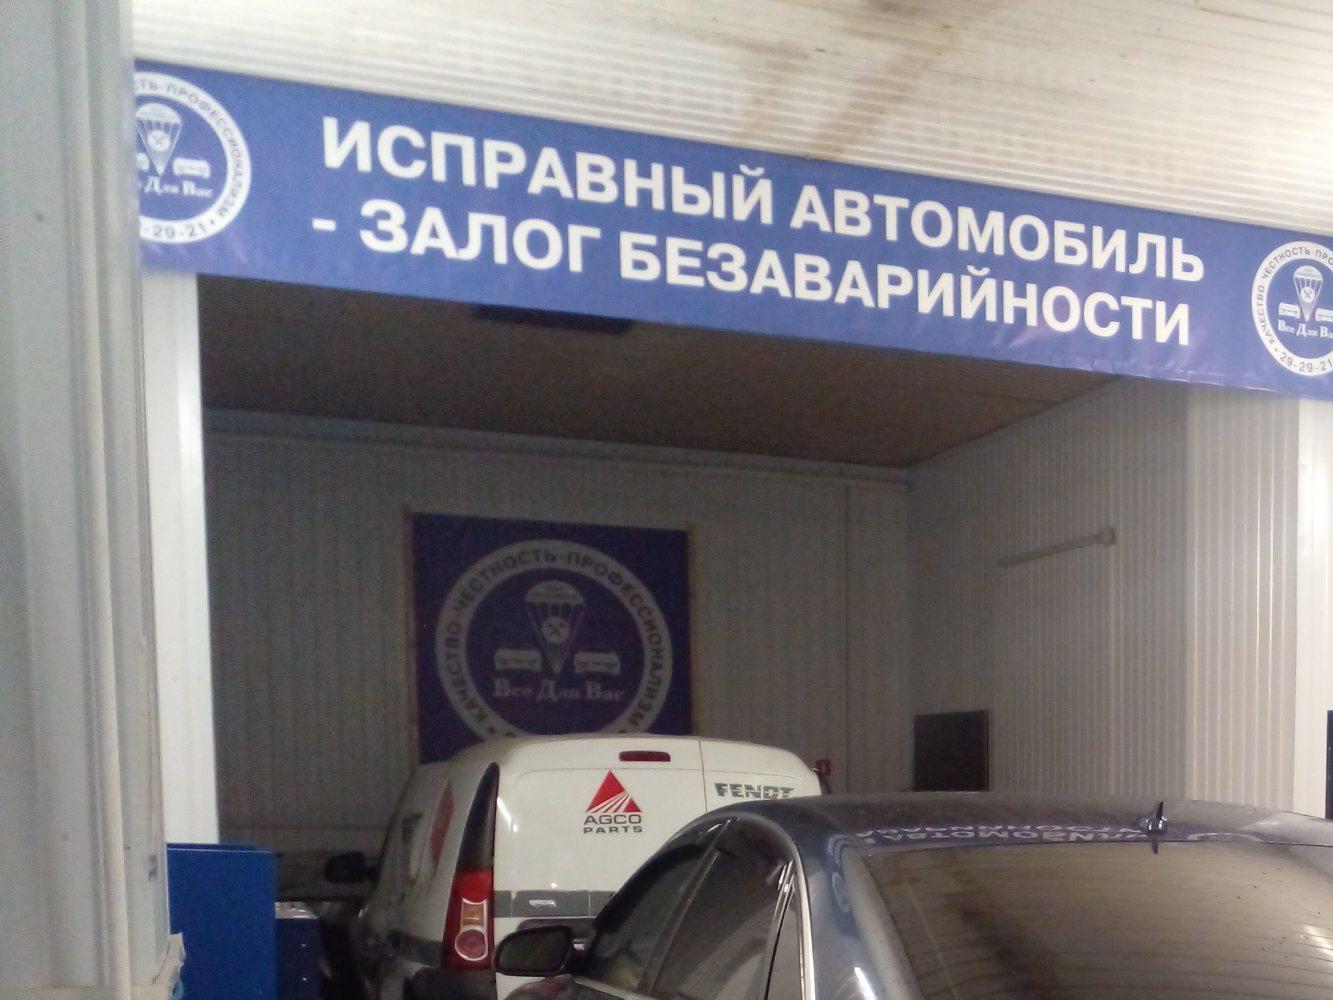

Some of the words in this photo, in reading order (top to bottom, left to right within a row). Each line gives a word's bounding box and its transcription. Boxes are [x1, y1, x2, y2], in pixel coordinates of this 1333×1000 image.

[321, 115, 774, 225] ИСПРАВНЫЙ
[790, 185, 1205, 283] АВТОМОБИЛЬ
[359, 199, 601, 273] ЗАЛОГ
[619, 234, 1190, 346] БЕЗАВАРИЙНОСТИ
[1261, 246, 1311, 279] ЧЕСТНОСТЬ
[1280, 352, 1333, 373] 29-29-21
[714, 783, 795, 800] FENDT
[583, 814, 642, 825] AGCO
[583, 826, 643, 834] PARTS
